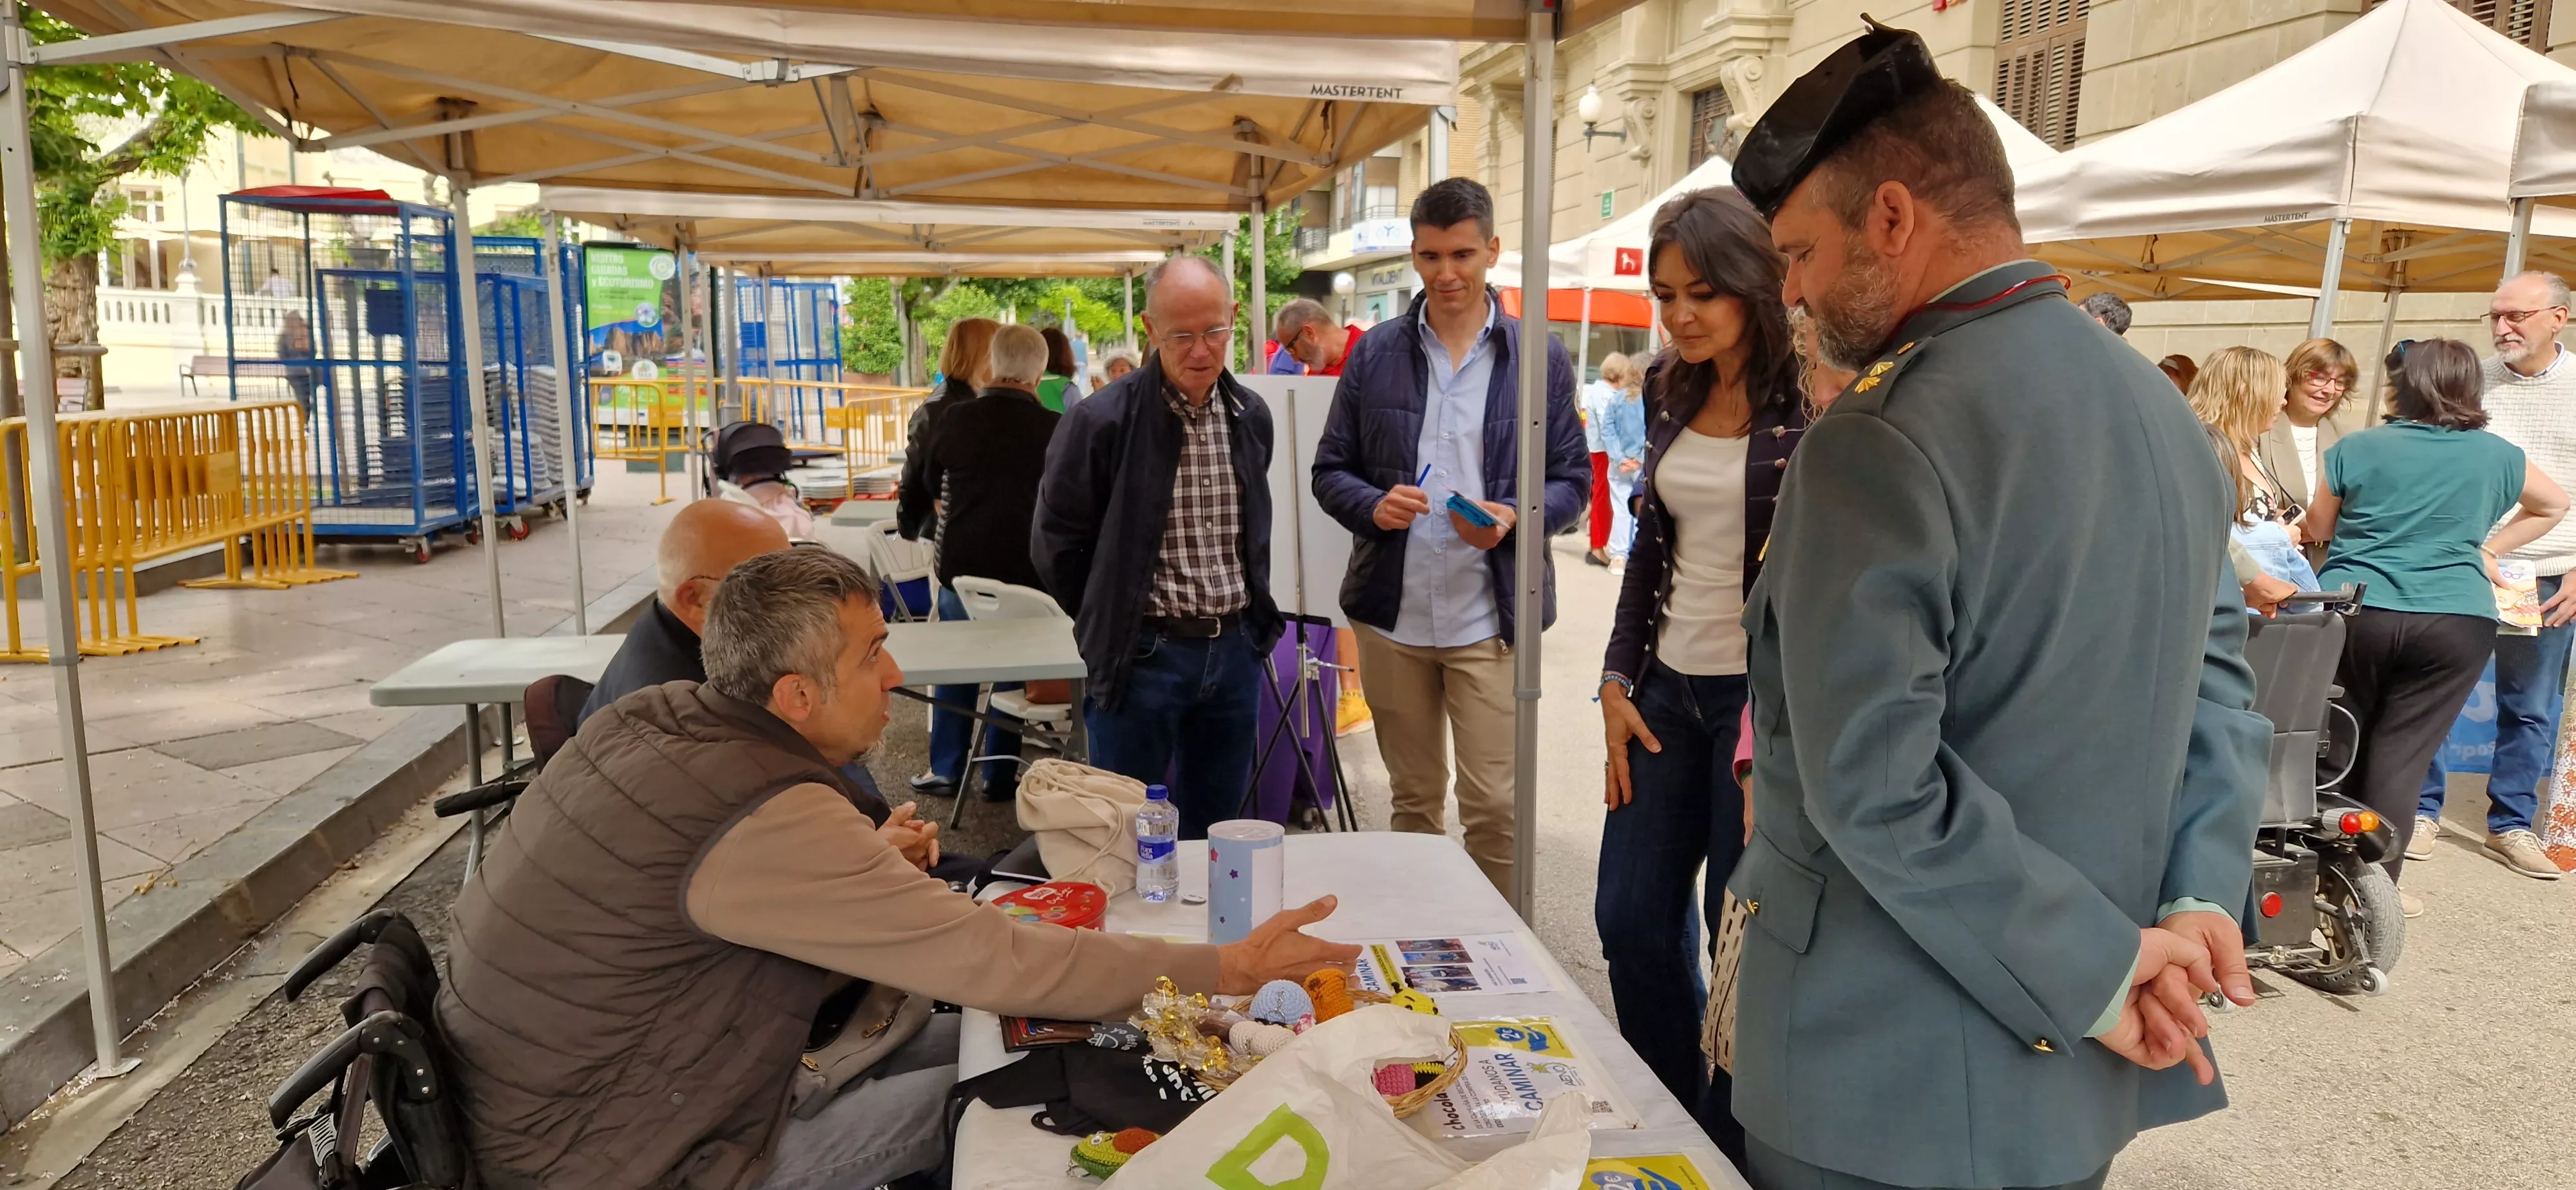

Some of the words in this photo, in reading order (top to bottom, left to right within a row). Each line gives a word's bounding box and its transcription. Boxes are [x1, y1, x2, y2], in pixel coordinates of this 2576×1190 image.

[1311, 84, 1403, 100] MASTERTENT
[2264, 212, 2309, 223] MASTERTENT
[591, 252, 624, 264] VISITAS
[591, 265, 628, 276] GUIADAS
[1357, 958, 1381, 992] CAMINAR
[1494, 1053, 1544, 1111] CAMINAR
[1432, 1090, 1465, 1130] chocola
